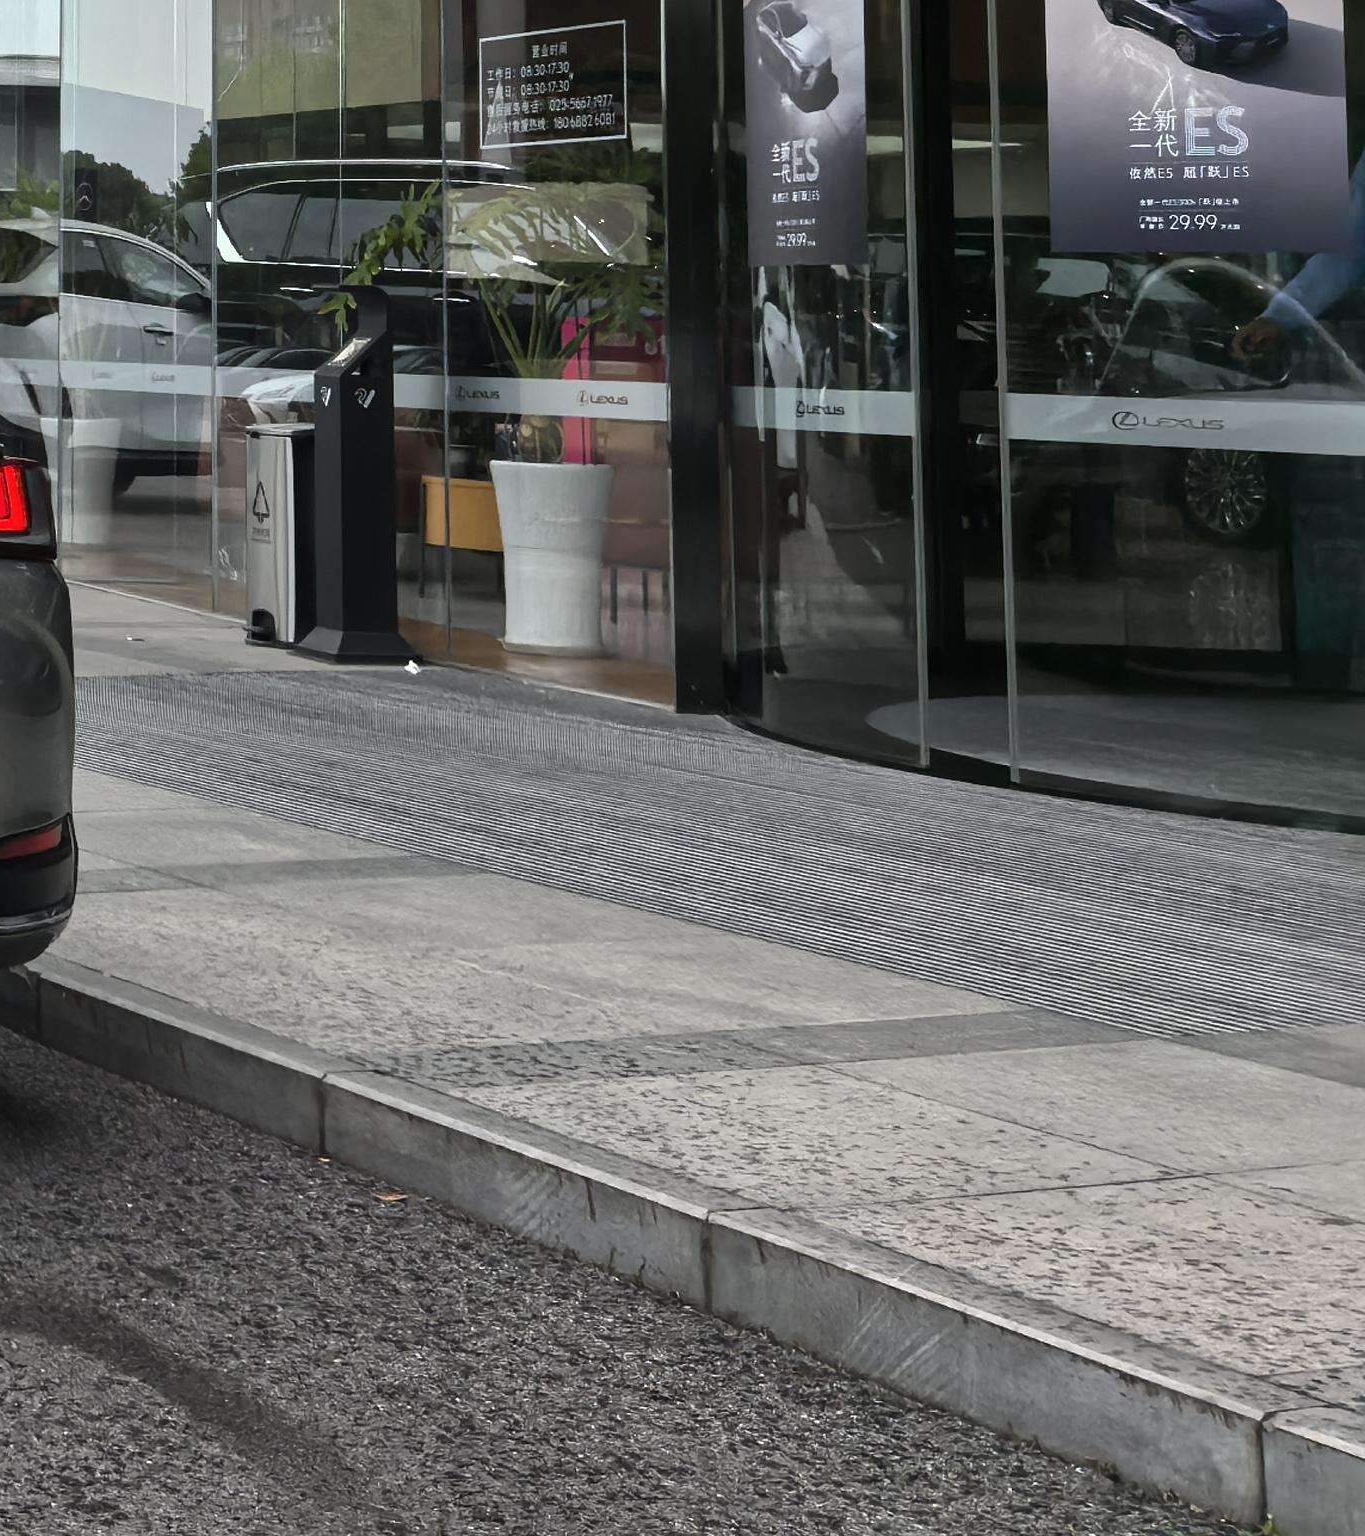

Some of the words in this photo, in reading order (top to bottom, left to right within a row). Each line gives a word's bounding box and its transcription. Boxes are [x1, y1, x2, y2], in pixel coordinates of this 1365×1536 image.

[486, 85, 516, 98] 节日：
[1128, 108, 1177, 132] 全新
[1184, 105, 1249, 156] ES
[1129, 133, 1179, 157] 一代
[792, 137, 820, 182] ES
[1169, 214, 1218, 230] 29.99
[806, 404, 845, 416] LEXUS
[1142, 416, 1225, 430] LEXUS
